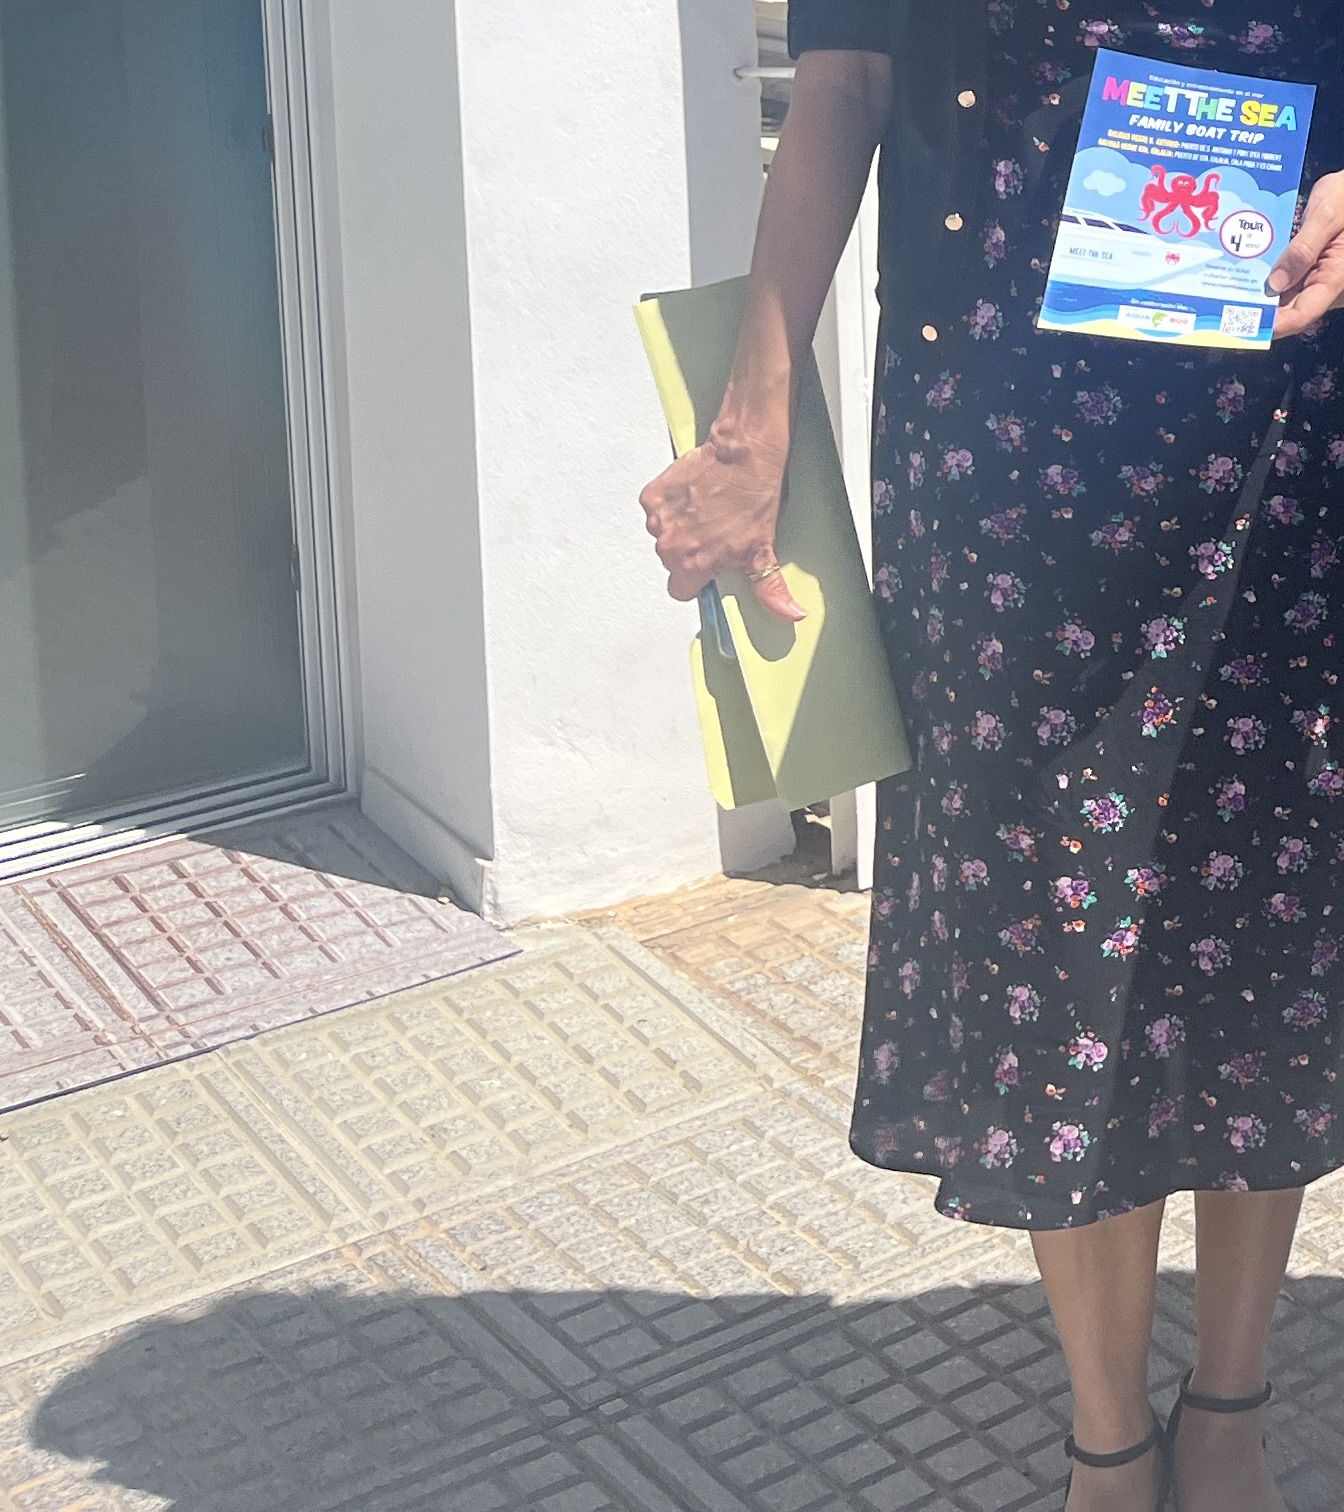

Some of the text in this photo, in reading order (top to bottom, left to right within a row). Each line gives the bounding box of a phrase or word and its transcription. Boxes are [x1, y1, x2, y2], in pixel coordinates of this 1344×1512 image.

[1240, 99, 1297, 131] SEA
[1129, 114, 1265, 144] FAMILY BOAT TRIP
[1239, 218, 1264, 232] TOUR
[1230, 234, 1242, 252] 4
